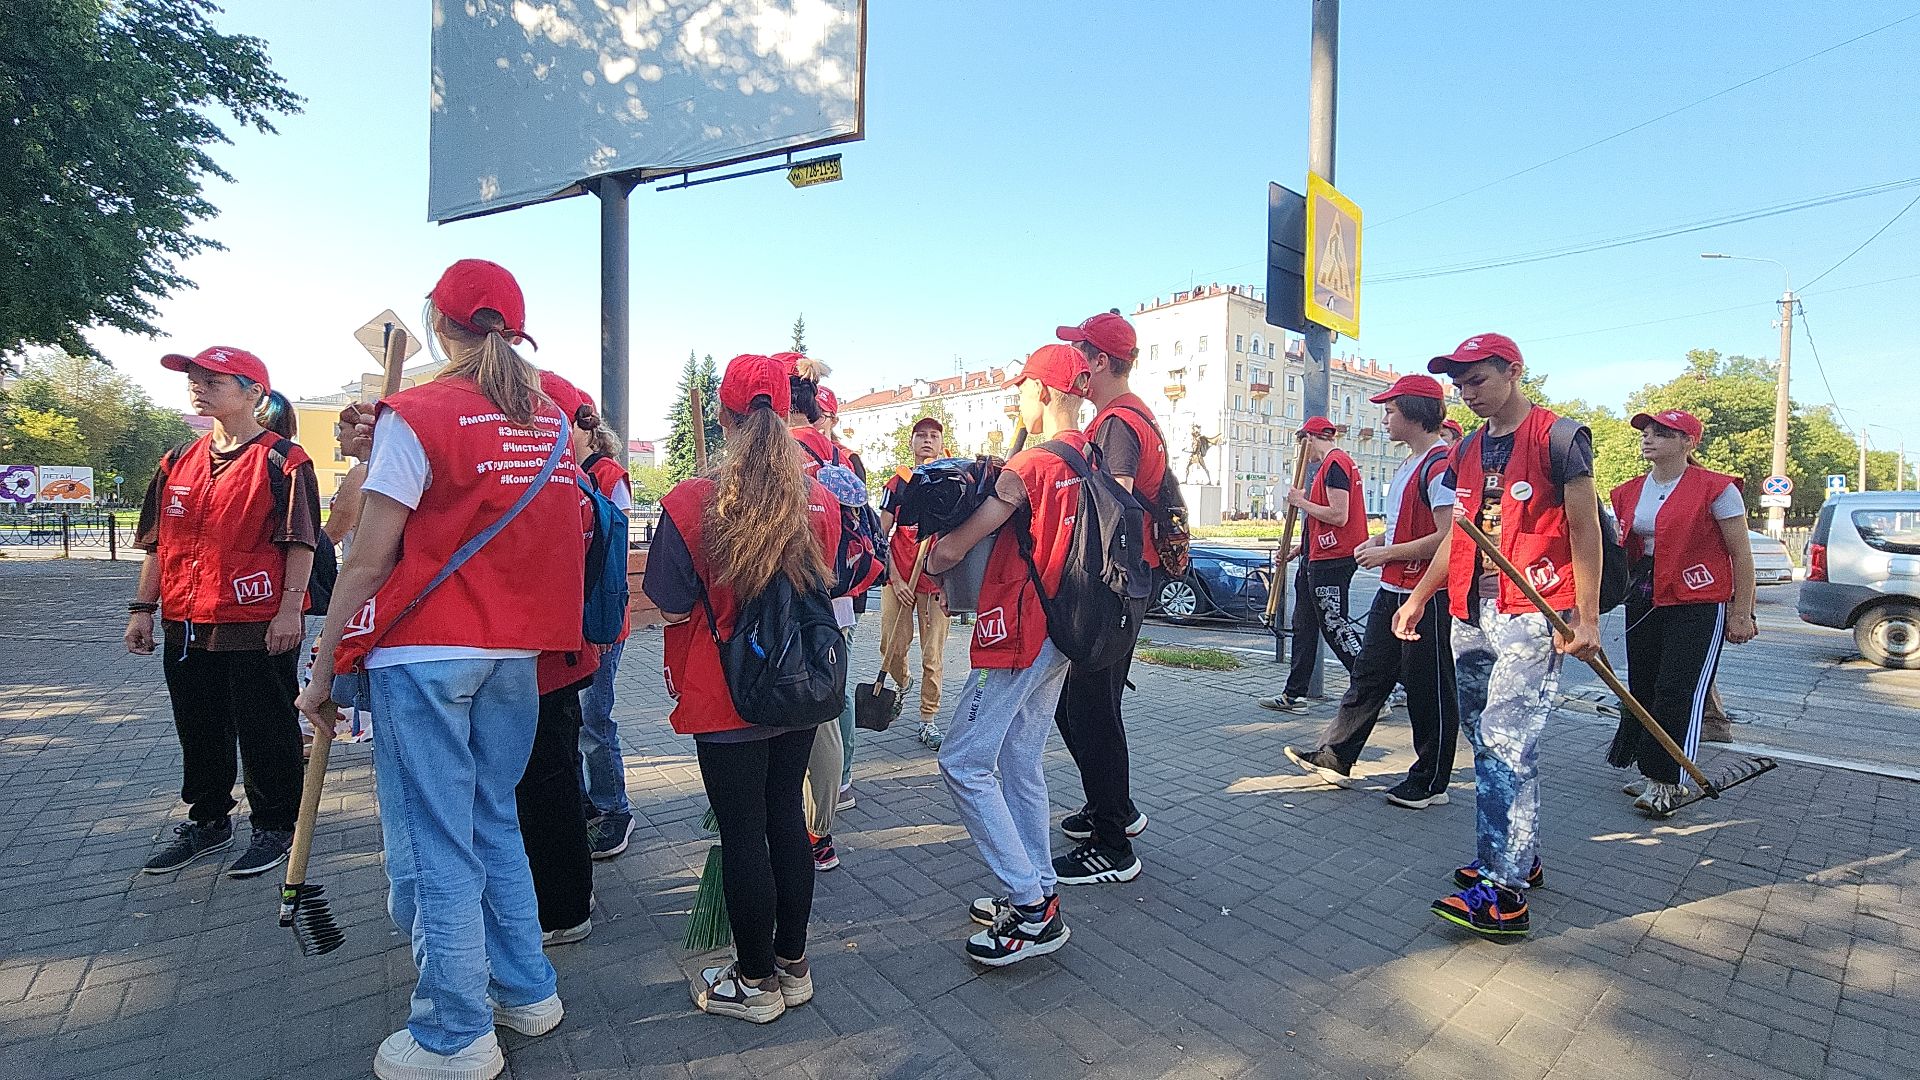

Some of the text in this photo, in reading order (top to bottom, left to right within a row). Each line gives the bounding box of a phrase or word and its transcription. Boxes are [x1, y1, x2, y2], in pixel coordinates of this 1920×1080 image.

[1486, 476, 1499, 488] B
[968, 668, 990, 722] MAKE THE FUTUR
